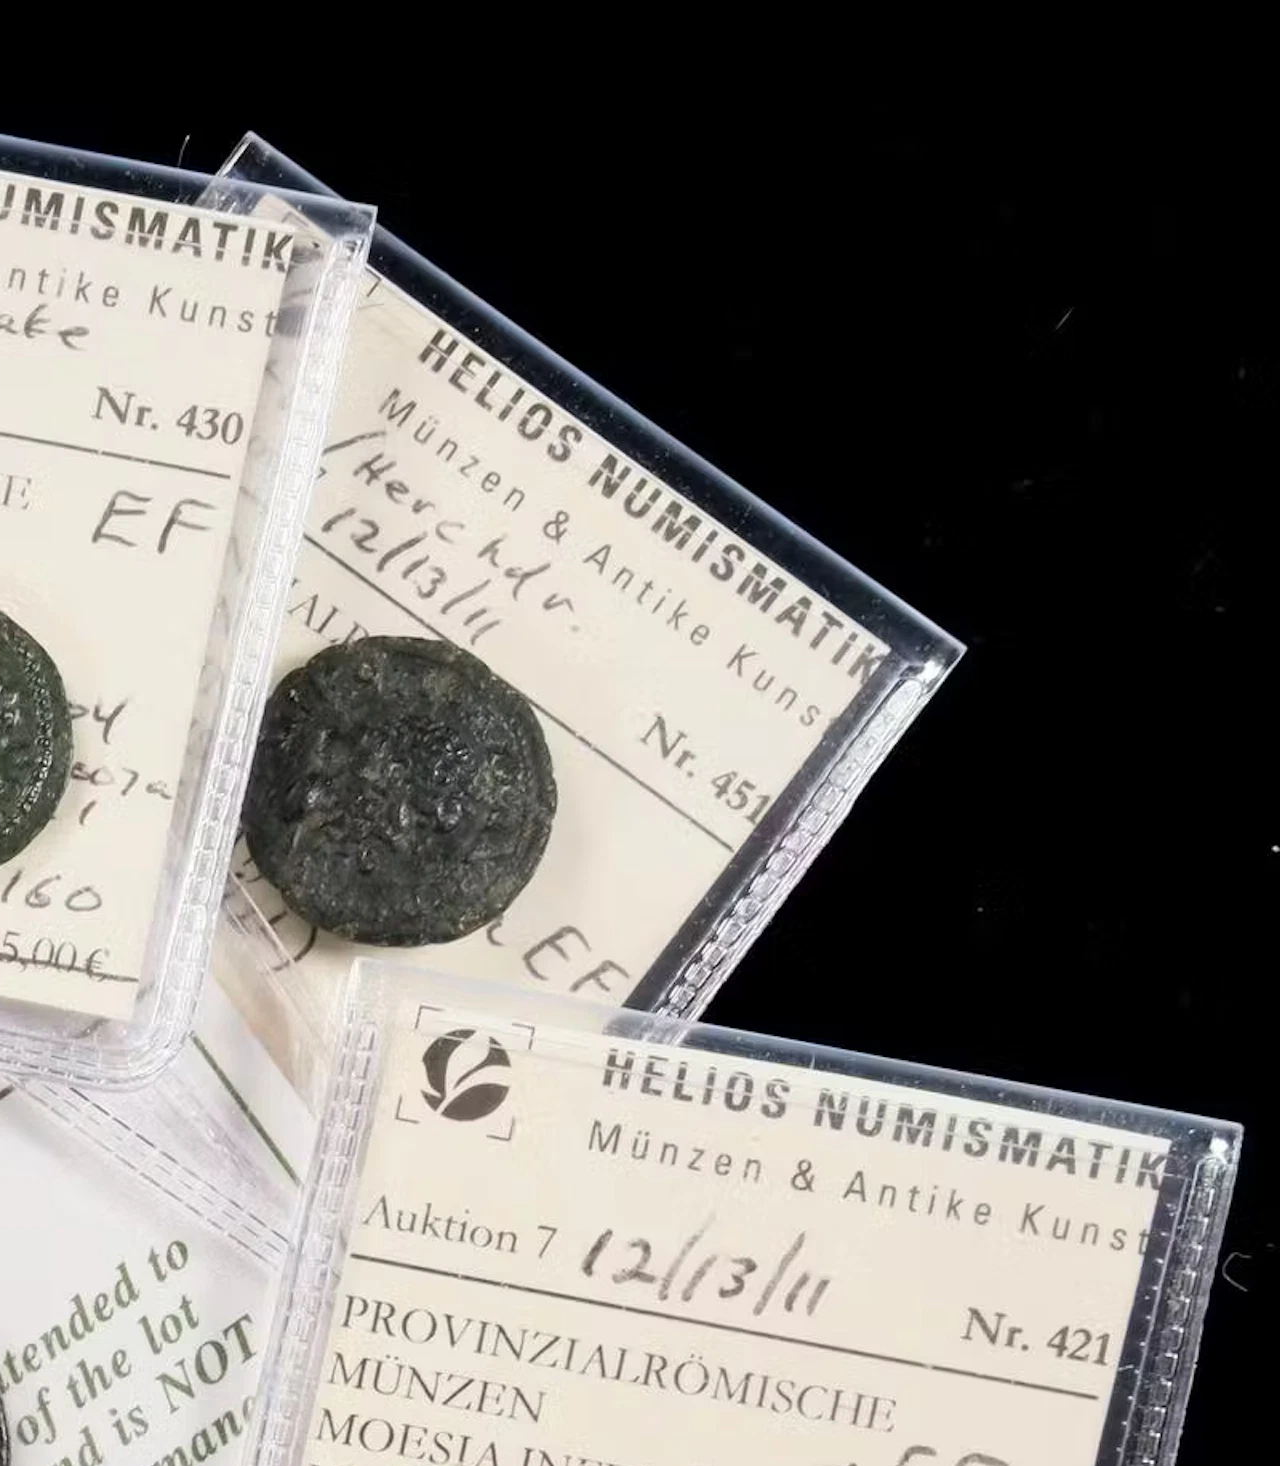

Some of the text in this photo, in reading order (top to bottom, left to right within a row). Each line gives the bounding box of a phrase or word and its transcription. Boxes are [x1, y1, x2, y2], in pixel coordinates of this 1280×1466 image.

[147, 273, 280, 337] Kunst
[92, 384, 244, 446] Nr. 430
[376, 386, 712, 648] Münzen & Antike
[417, 327, 585, 464] HELIOS
[587, 453, 891, 689] NUMISMATIK
[639, 712, 771, 827] Nr. 451
[602, 1047, 1172, 1192] HELIOS NUMISMATIK
[363, 1193, 561, 1261] Auktion 7
[587, 1119, 1152, 1258] Münzen & Antike Kunst
[147, 1234, 191, 1284] to
[15, 1300, 202, 1449] of the lot
[110, 1406, 151, 1446] is
[152, 1312, 261, 1416] NOT
[325, 1350, 547, 1425] MÜNZEN
[340, 1292, 898, 1435] PROVINZIALRÖMISCHE
[961, 1307, 1112, 1368] Nr. 421
